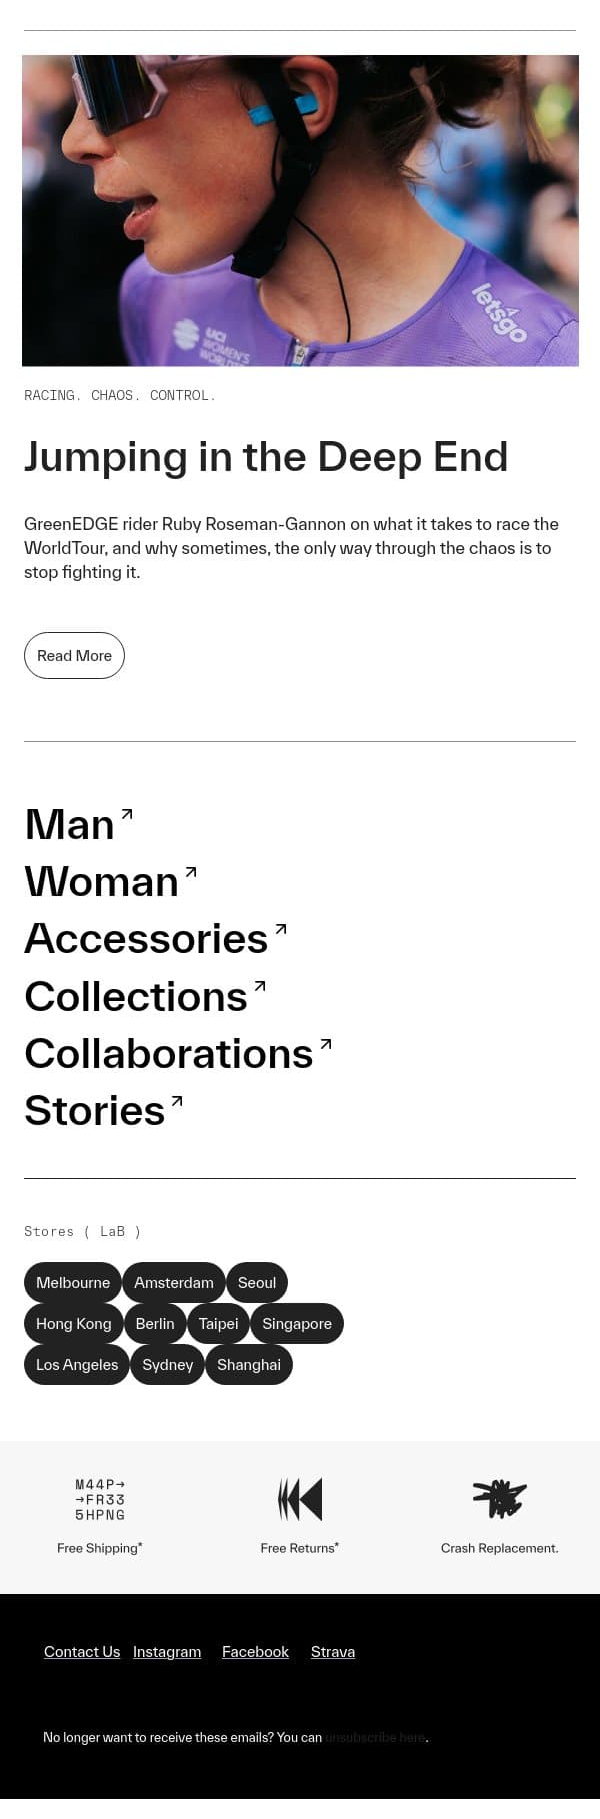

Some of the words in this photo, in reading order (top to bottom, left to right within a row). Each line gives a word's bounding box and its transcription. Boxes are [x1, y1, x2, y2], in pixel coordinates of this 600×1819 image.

[205, 327, 228, 343] UCI
[203, 338, 250, 364] WOMEN'S
[25, 390, 80, 400] RACING.
[92, 389, 138, 400] CHAOS.
[151, 390, 214, 401] CONTROL.
[24, 441, 186, 479] Jumping
[200, 441, 231, 471] in
[242, 441, 306, 471] the
[320, 441, 421, 479] Deep
[435, 441, 507, 471] End
[24, 567, 58, 582] stop
[62, 564, 121, 581] fighting
[127, 565, 140, 578] it.
[38, 650, 72, 661] Read
[76, 649, 112, 661] More
[27, 809, 113, 840] Man
[24, 866, 177, 897] Woman
[24, 923, 267, 953] Accessories
[26, 981, 247, 1011] Collections
[26, 1038, 312, 1068] Collaborations
[25, 1095, 164, 1126] Stories
[25, 1226, 73, 1237] Stores
[101, 1226, 124, 1236] LaB
[37, 1277, 110, 1289] Melbourne
[134, 1276, 213, 1289] Amsterdam
[238, 1276, 276, 1289] Seoul
[37, 1318, 72, 1332] Hong
[77, 1317, 111, 1332] Kong
[136, 1318, 174, 1329] Berlin
[199, 1318, 238, 1333] Taipei
[263, 1318, 332, 1332] Singapore
[37, 1359, 59, 1370] Los
[62, 1358, 118, 1373] Angeles
[142, 1358, 194, 1374] Sydney
[218, 1359, 280, 1373] Shanghai
[76, 1479, 114, 1490] M44P
[87, 1494, 124, 1505] FR33
[76, 1509, 124, 1520] 5HPNG
[58, 1543, 83, 1553] Free
[261, 1543, 286, 1553] Free
[441, 1543, 475, 1553] Crash
[479, 1543, 558, 1555] Replacement.
[44, 1646, 99, 1657] Contact
[103, 1646, 120, 1657] Us
[133, 1645, 202, 1660] Instagram
[223, 1646, 289, 1657] Facebook
[312, 1646, 355, 1657] Strava
[44, 1731, 60, 1743] No
[64, 1732, 100, 1745] longer
[103, 1733, 132, 1743] want
[134, 1733, 146, 1742] to
[150, 1732, 192, 1743] receive
[195, 1732, 227, 1743] these
[231, 1732, 274, 1743] emails?
[277, 1732, 298, 1742] You
[301, 1735, 322, 1743] can
